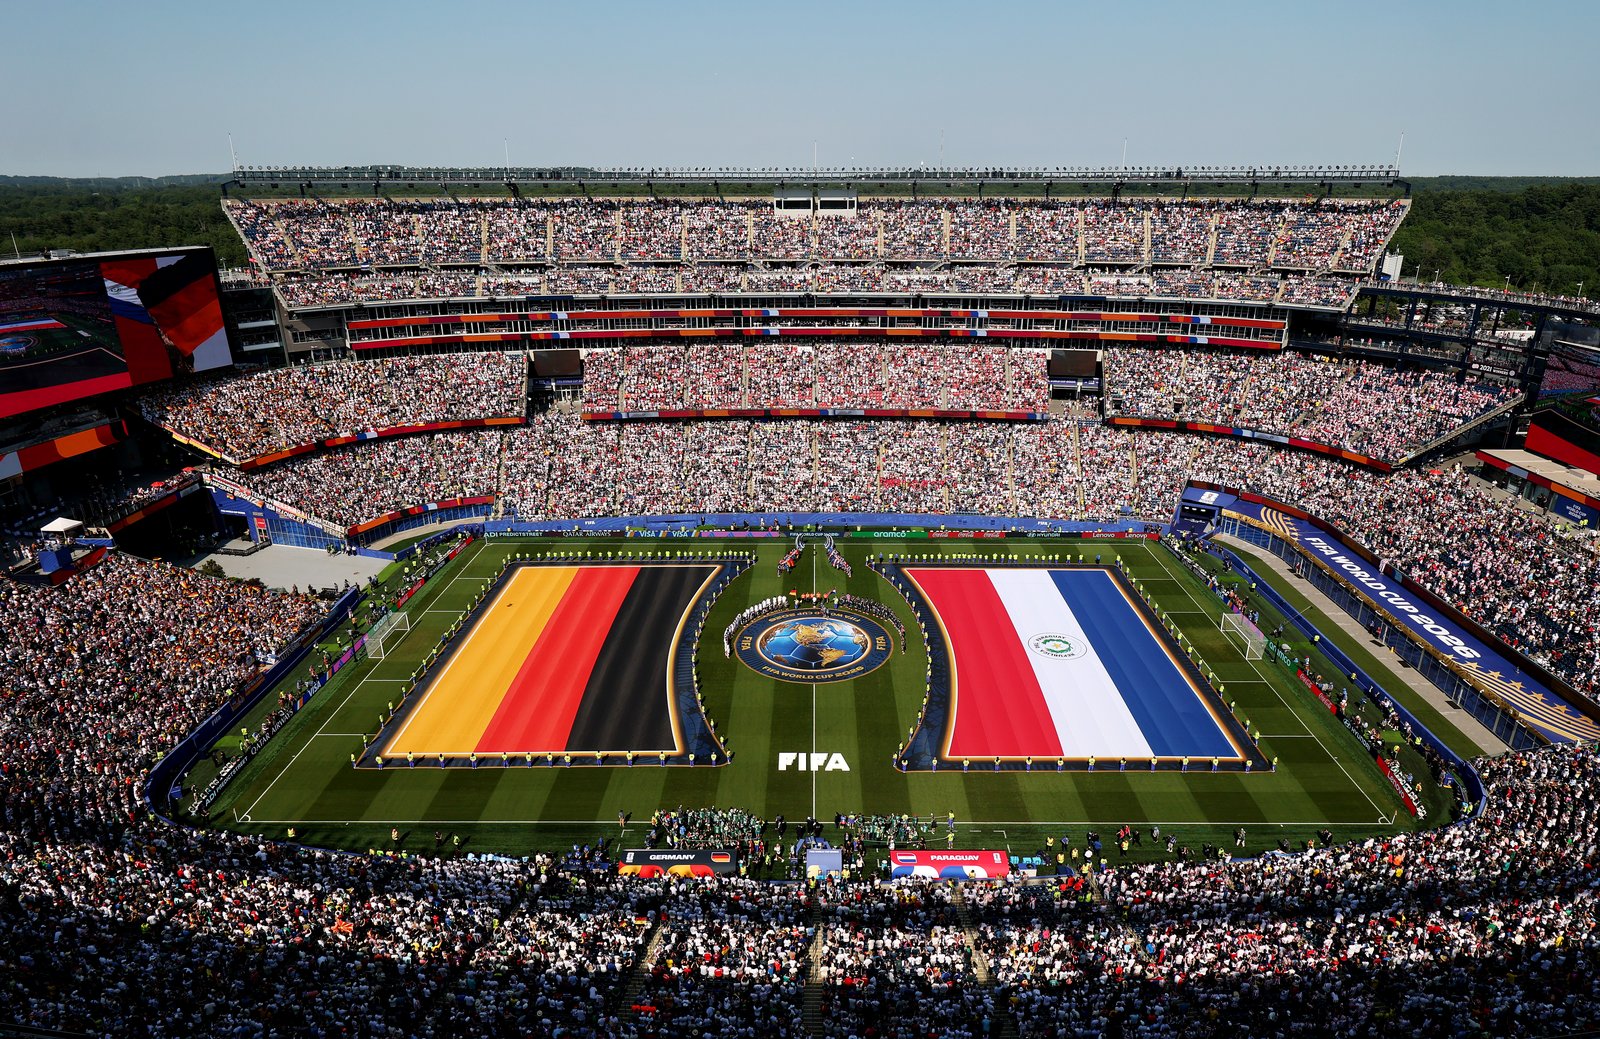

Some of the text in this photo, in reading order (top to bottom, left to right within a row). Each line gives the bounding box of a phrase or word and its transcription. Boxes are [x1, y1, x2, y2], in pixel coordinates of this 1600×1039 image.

[1480, 364, 1493, 372] 2021
[1304, 537, 1482, 660] FIFA WORLD CUP 2026
[741, 636, 753, 651] FIFA
[876, 636, 887, 651] FIFA
[762, 665, 781, 675] FIFA
[781, 670, 814, 680] WORLD
[835, 665, 865, 678] 2026
[308, 681, 323, 697] VISA
[250, 709, 294, 755] QATAR AIRWAYS
[1351, 726, 1371, 752] HYUNDAI
[778, 752, 851, 772] FIFA
[217, 756, 249, 793] PREDICTSTREET
[1387, 770, 1405, 799] Lenovo
